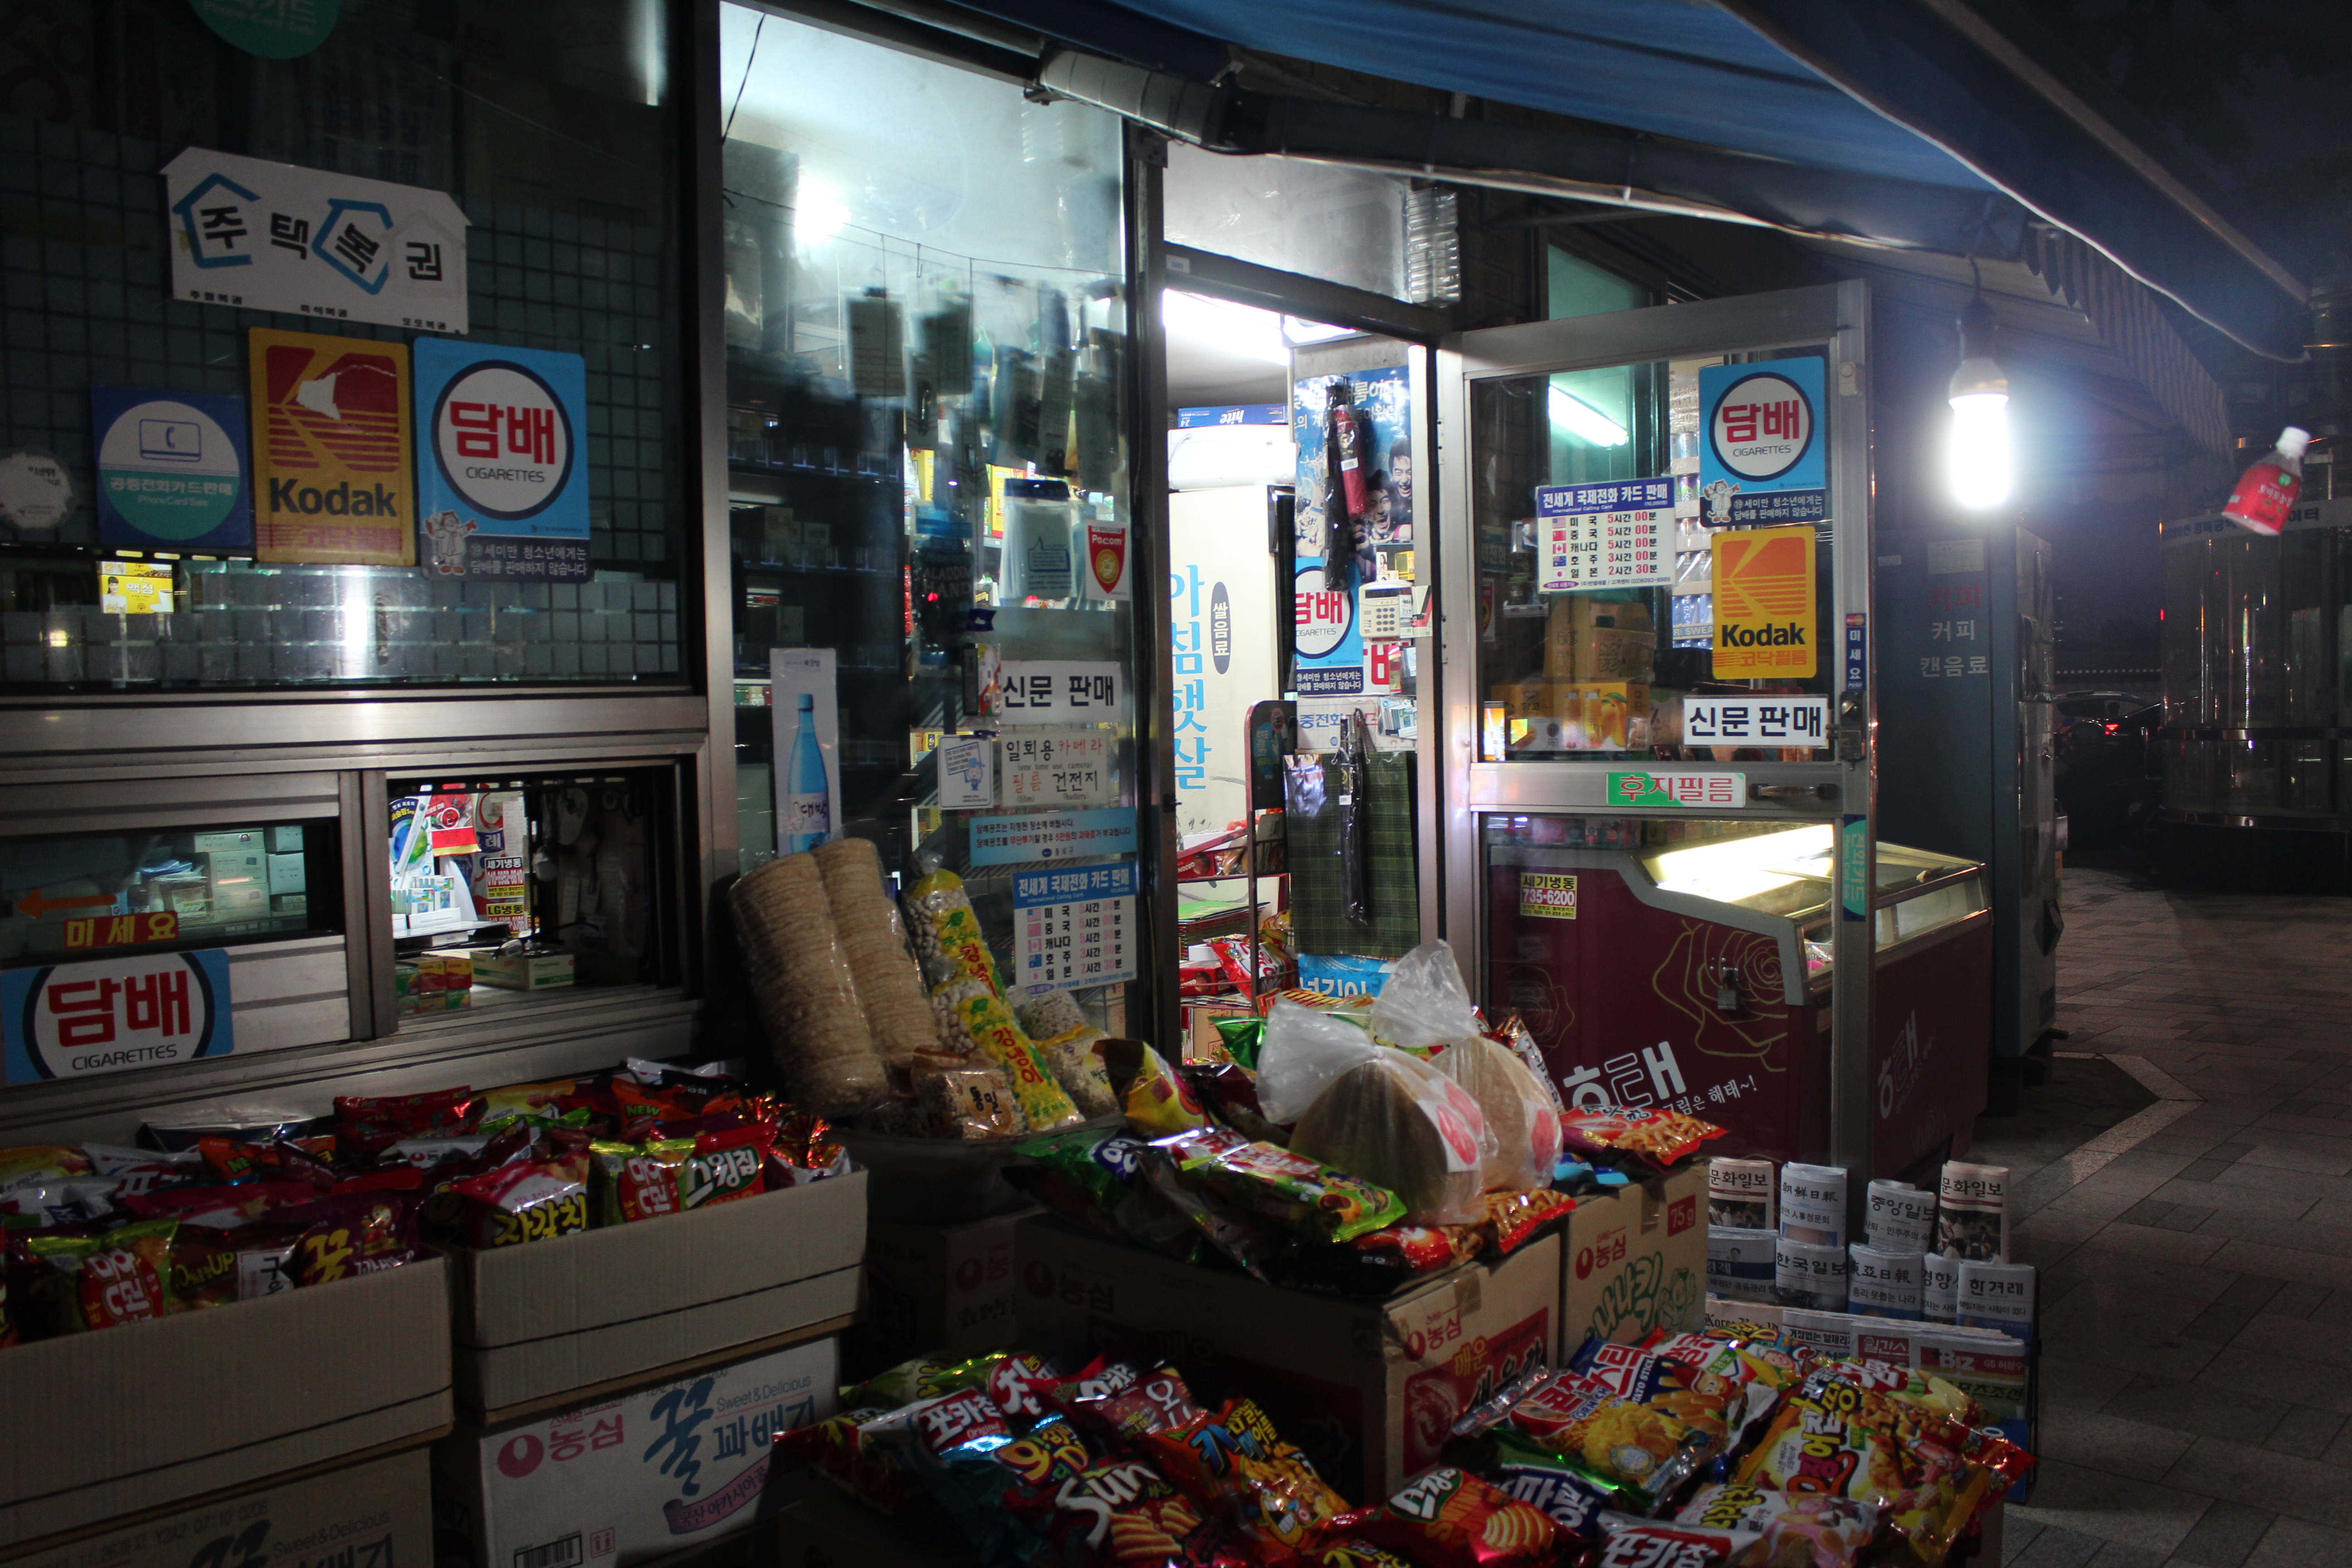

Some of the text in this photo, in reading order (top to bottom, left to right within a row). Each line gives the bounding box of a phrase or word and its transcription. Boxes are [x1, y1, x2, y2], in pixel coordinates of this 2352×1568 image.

[201, 206, 442, 281] 주택복권
[1722, 400, 1799, 443] 담배
[450, 401, 555, 465] 담배
[1733, 445, 1791, 457] CIGARETTES
[466, 466, 545, 483] CIGARETTES
[270, 478, 397, 517] Kodak
[1543, 483, 1667, 509] 전세계 국제전화 카드 판매
[1773, 495, 1823, 507] 청소년에게는
[1608, 511, 1656, 523] 5시간 00분
[1734, 505, 1823, 520] 담배를 판매하지 않습니다
[1608, 524, 1656, 536] 5시간 00분
[523, 546, 587, 560] 청소년에게는
[1570, 538, 1656, 553] 캐나다 5시간 00분
[1608, 551, 1657, 562] 3시간 00분
[470, 561, 587, 576] 담배를 판매하지 않습니다
[1608, 564, 1657, 575] 2시간 30분
[127, 578, 154, 594] 맥심
[1927, 584, 1981, 610] 커피
[1296, 592, 1343, 625] 담배
[1213, 602, 1229, 657] 쌀음료
[1722, 622, 1806, 647] Kodak
[1932, 620, 1975, 641] 커피
[1740, 650, 1808, 666] 코닥필름
[1921, 656, 1989, 677] 캔음료
[1297, 681, 1361, 691] 담배를 판매하지 않습니다
[1323, 671, 1361, 681] 청소년에게는
[1004, 676, 1114, 707] 신문 판매
[1690, 706, 1821, 737] 신문 판매
[1007, 738, 1102, 762] 일회용 카메라
[1053, 770, 1097, 792] 건전지
[1619, 775, 1734, 803] 후지필름
[976, 823, 1007, 834] 담배꽁초는
[1010, 823, 1027, 831] 지정된
[1030, 821, 1047, 829] 장소에
[977, 837, 1008, 848] 담배꽁초를
[1042, 833, 1053, 843] 경우
[1018, 868, 1129, 897] 전세계 국제전화 카드 판매
[1524, 876, 1574, 890] 세기냉동
[1523, 888, 1575, 906] 735-6200
[1045, 936, 1071, 950] 캐나다
[48, 970, 190, 1048] 담배
[72, 1044, 177, 1071] CIGARETTES
[992, 1027, 1044, 1083] 강냉이
[626, 1104, 661, 1117] NEW
[1710, 1170, 1768, 1188] 문화일보
[1941, 1177, 2004, 1198] 문화일보
[1782, 1182, 1838, 1202] 朝鮮日報
[1871, 1195, 1934, 1221] 중앙일보
[493, 1196, 586, 1246] 자갈치
[1887, 1226, 1919, 1240] 민주주의
[1596, 1234, 1626, 1269] 농심
[1777, 1253, 1847, 1275] 한국일보
[1849, 1259, 1911, 1284] 東亞日報
[1970, 1279, 2023, 1295] 한겨레
[1899, 1295, 1915, 1304] 나라
[1988, 1304, 2009, 1314] 사람이
[1427, 1314, 1462, 1351] 농심
[1454, 1337, 1488, 1377] 매운
[1984, 1359, 1996, 1368] GS
[717, 1393, 752, 1412] Sweet
[763, 1375, 811, 1398] Delicious
[549, 1414, 624, 1461] 농심
[643, 1377, 715, 1496] 꿀
[713, 1396, 814, 1462] 꽈배기
[329, 1511, 390, 1540] Delicious
